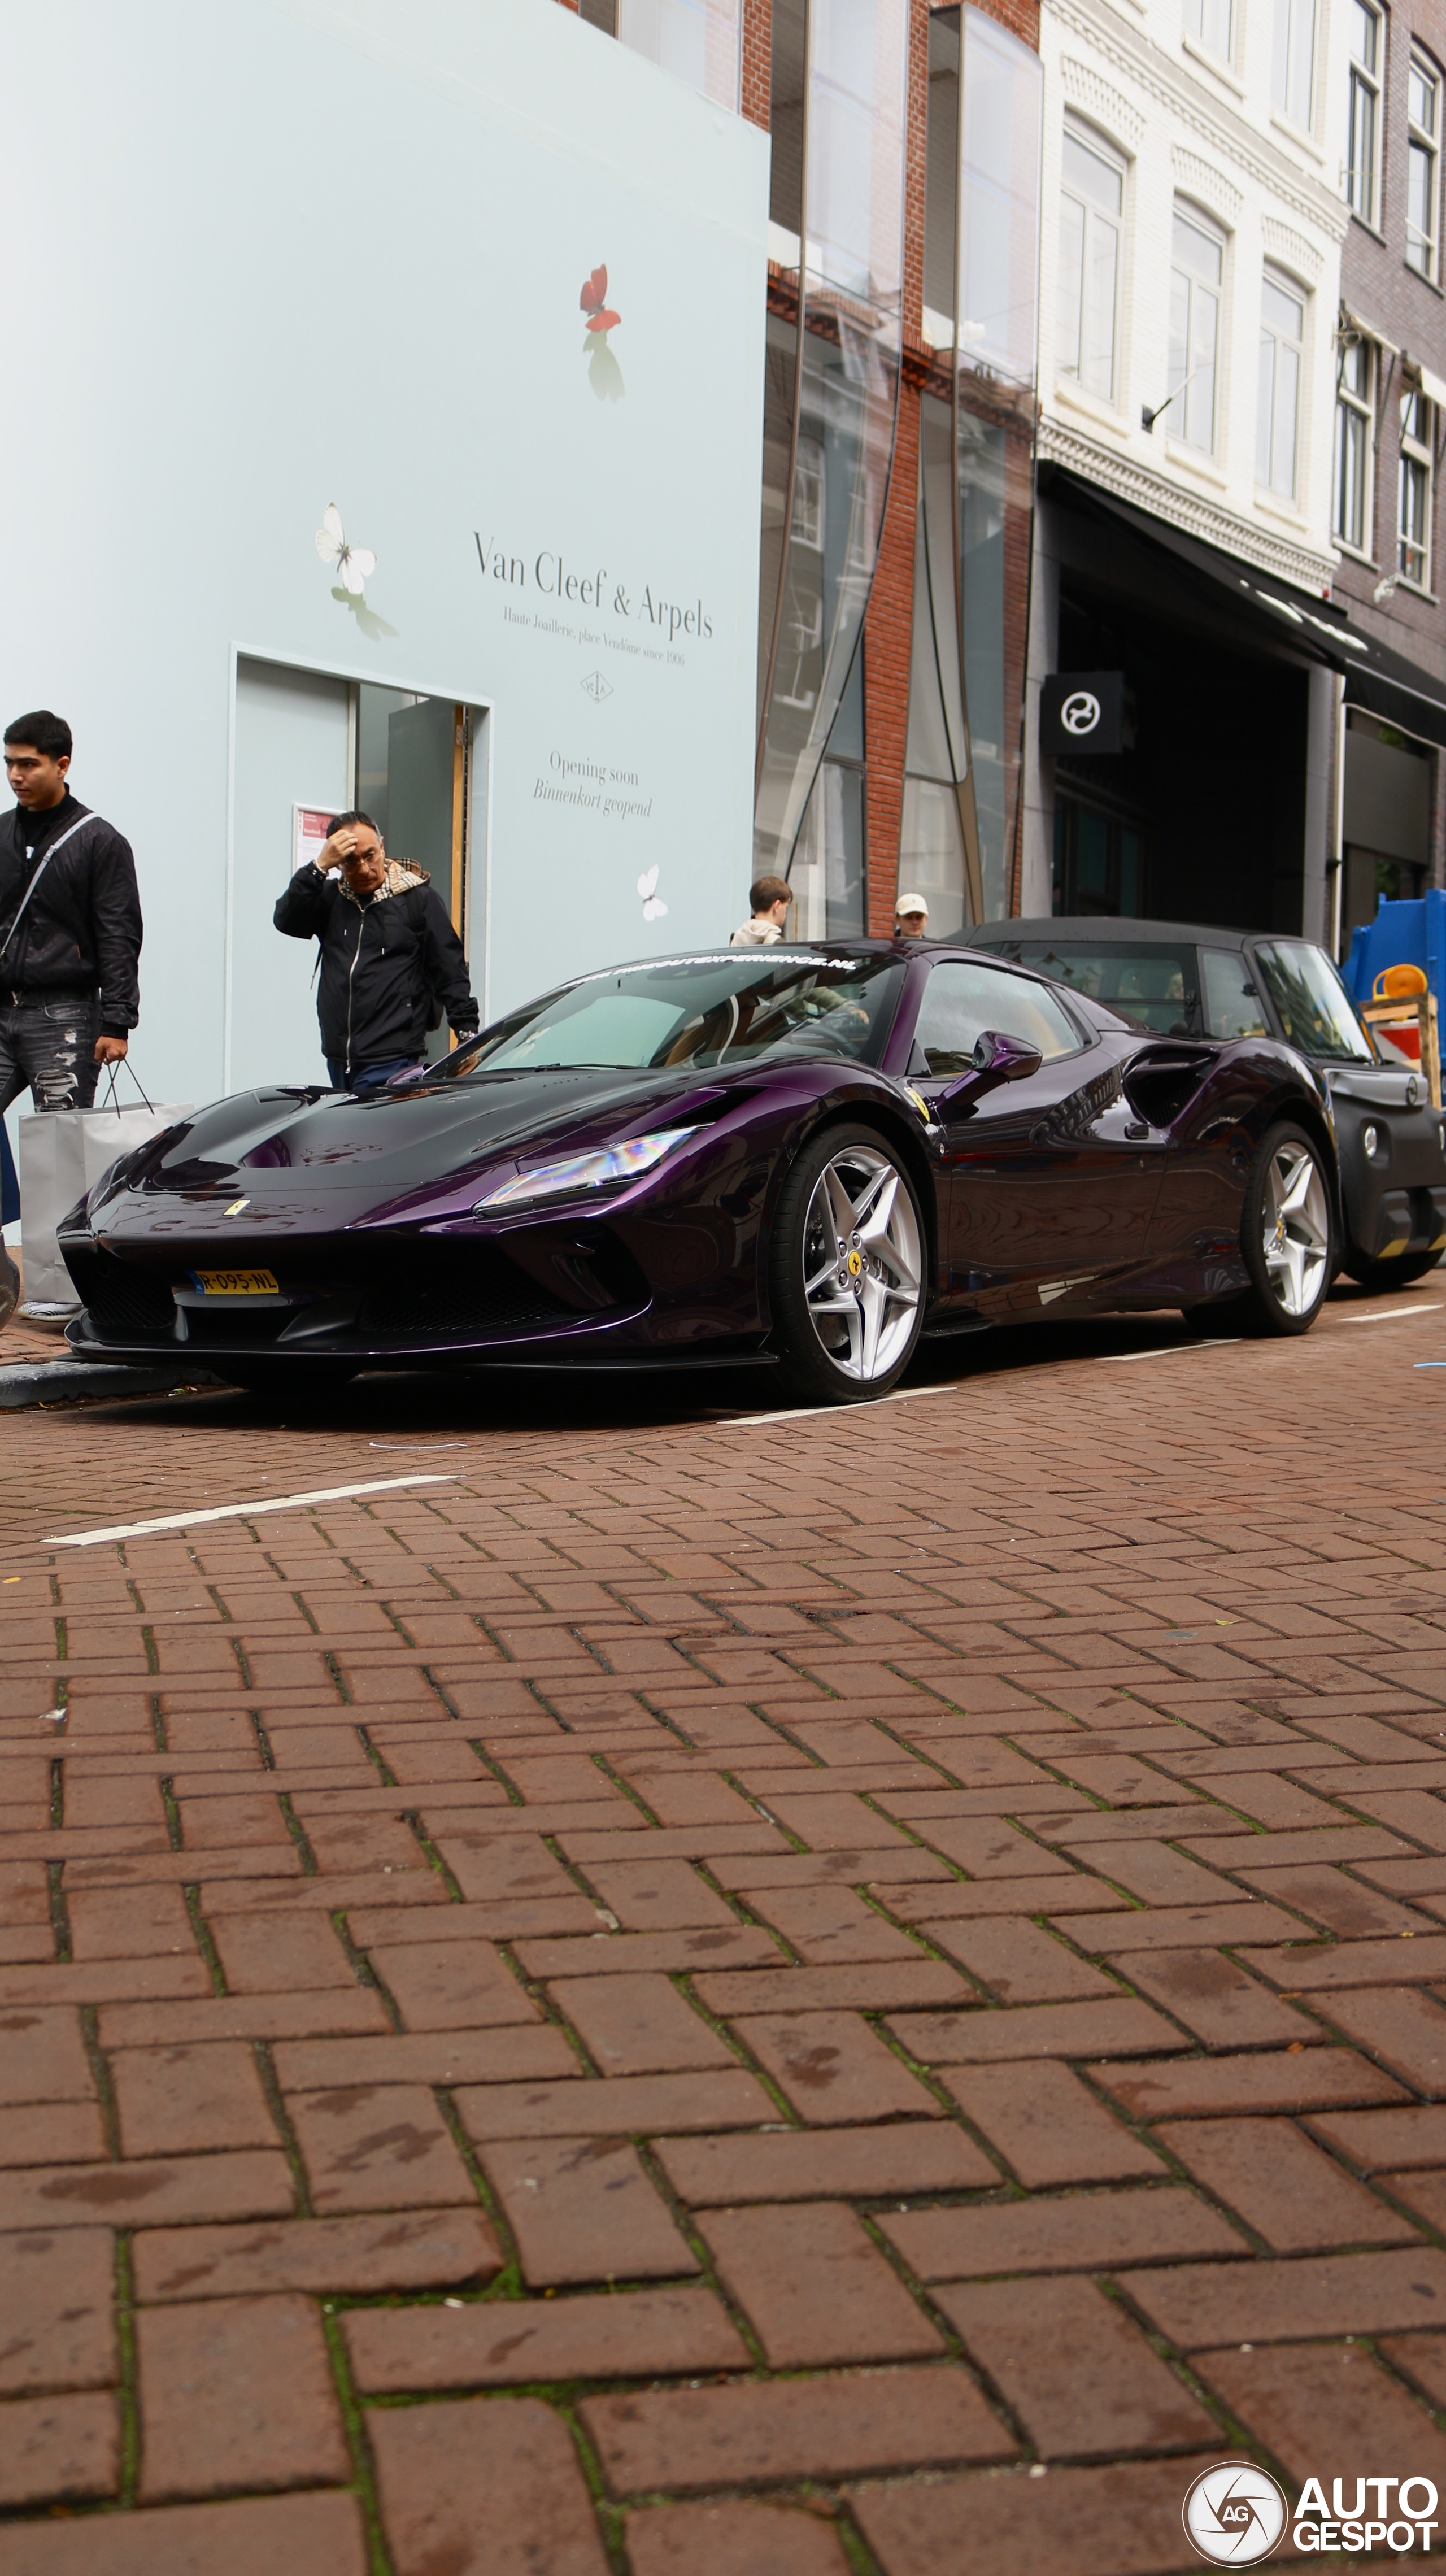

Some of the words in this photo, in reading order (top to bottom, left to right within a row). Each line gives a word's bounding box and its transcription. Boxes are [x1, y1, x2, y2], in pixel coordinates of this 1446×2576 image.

[473, 530, 525, 586] Van
[534, 551, 607, 607] Cleef
[613, 584, 631, 616] &
[637, 584, 713, 642] Arpels
[503, 606, 532, 626] Haute
[533, 614, 576, 640] Joaillerie,
[578, 627, 601, 645] place
[642, 644, 664, 660] since
[666, 650, 685, 667] 1906
[549, 750, 607, 786] Opening
[609, 768, 639, 786] soon
[533, 778, 602, 808] Binnenkort
[602, 798, 653, 820] geopend
[199, 1273, 277, 1290] R-095-NL
